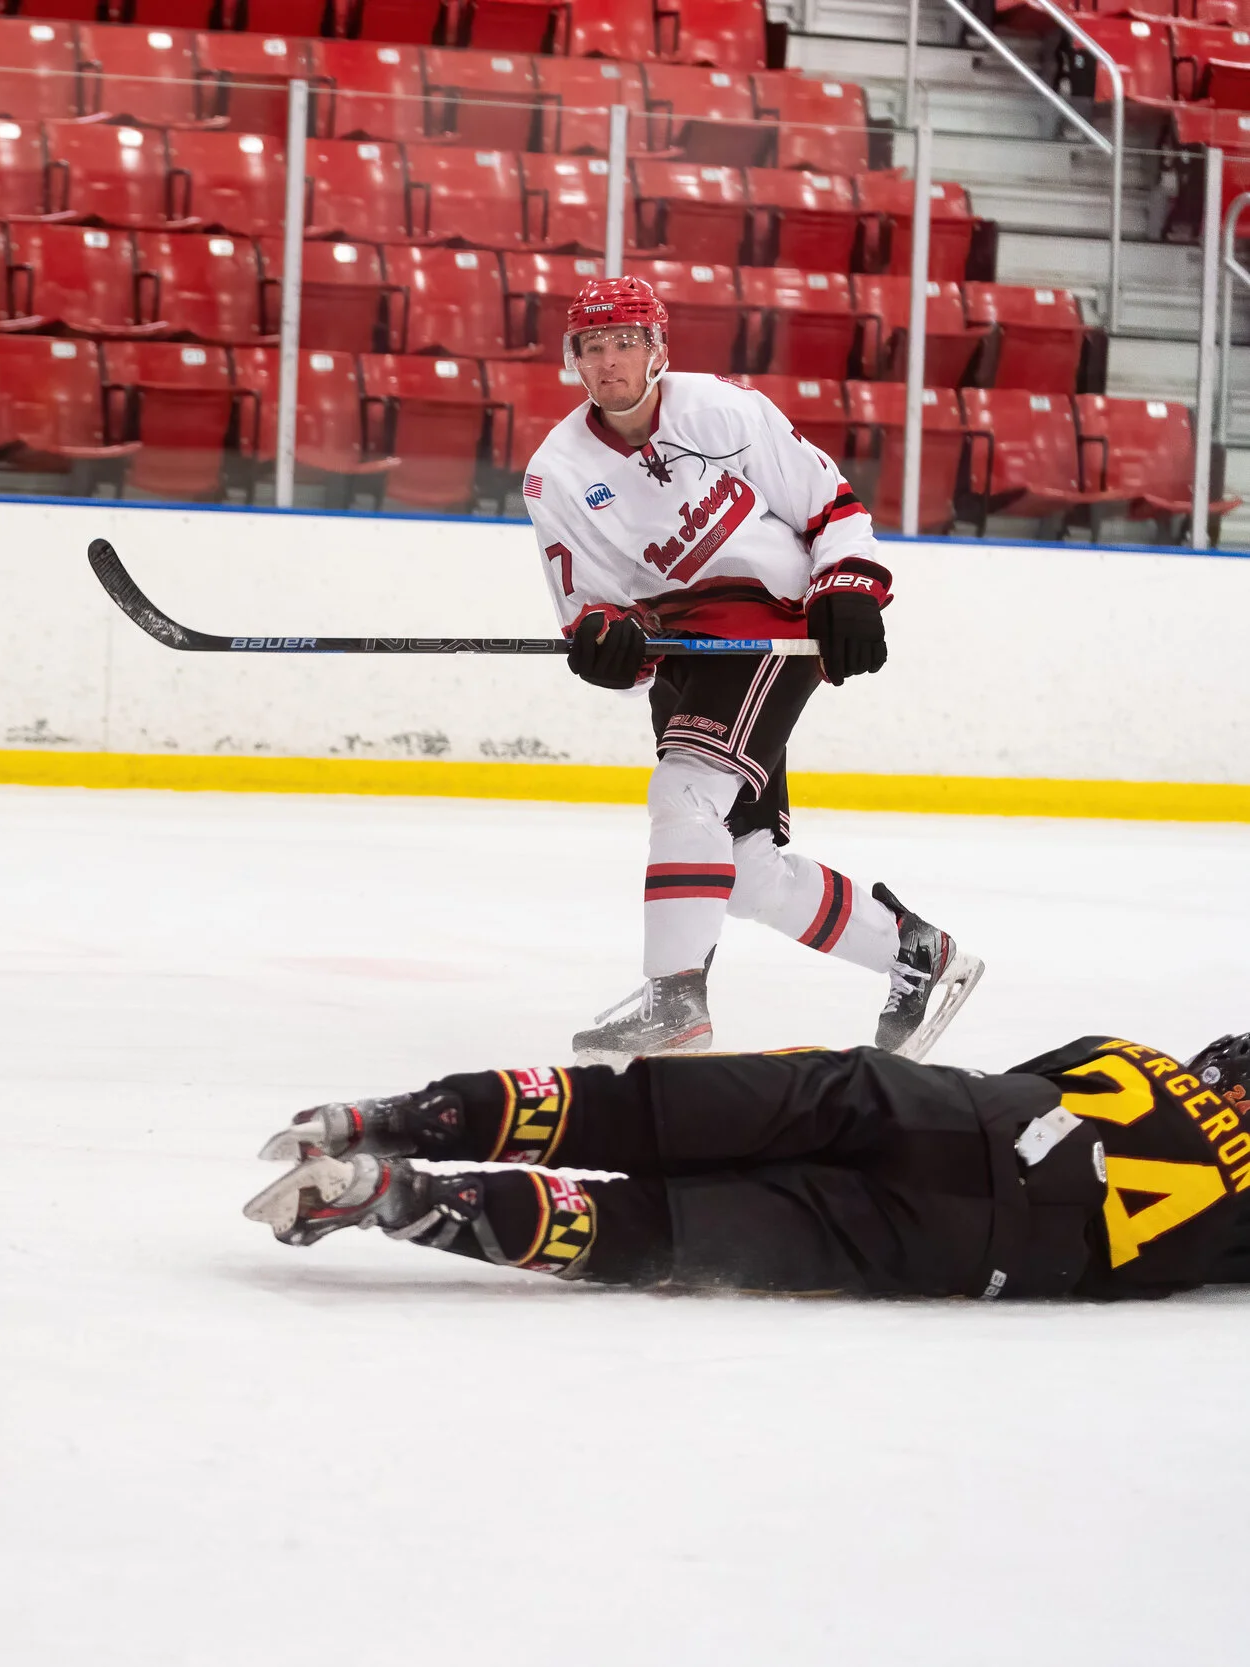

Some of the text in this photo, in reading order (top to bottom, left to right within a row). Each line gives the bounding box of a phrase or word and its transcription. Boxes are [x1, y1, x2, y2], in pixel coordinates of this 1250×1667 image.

[583, 302, 615, 314] TITANS
[585, 486, 617, 509] NAHL
[643, 470, 738, 574] New Jersey
[692, 523, 728, 564] TITANS
[545, 541, 576, 597] 7
[802, 574, 874, 615] AUER
[695, 639, 770, 649] NEXUS
[666, 714, 728, 737] AUER
